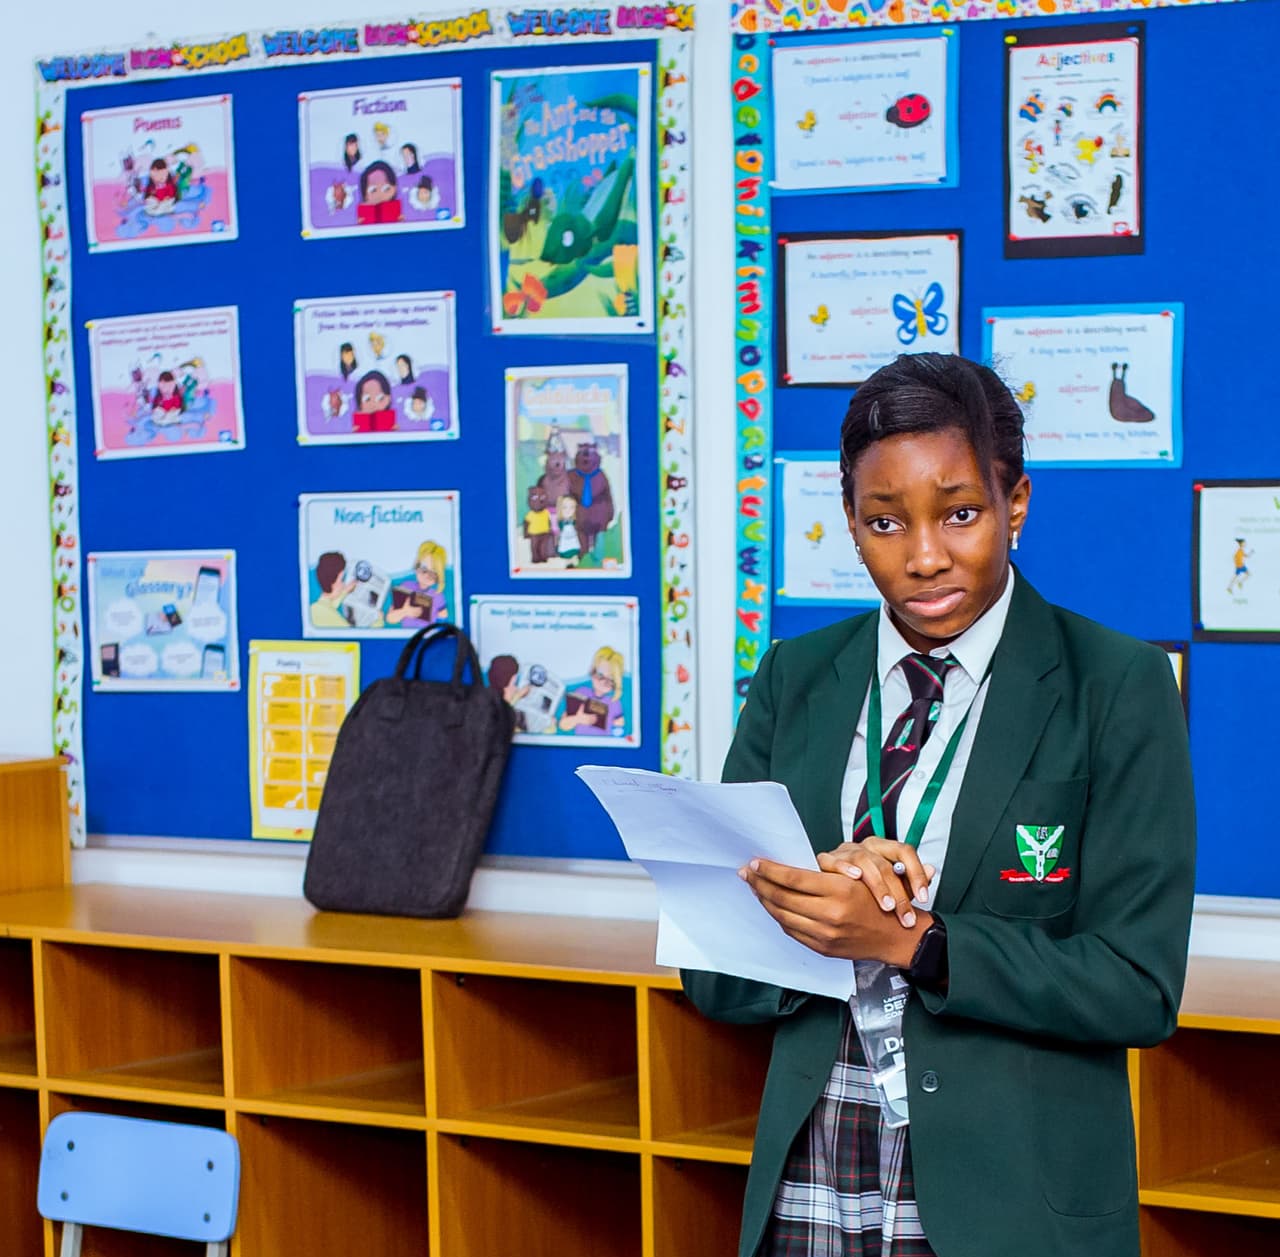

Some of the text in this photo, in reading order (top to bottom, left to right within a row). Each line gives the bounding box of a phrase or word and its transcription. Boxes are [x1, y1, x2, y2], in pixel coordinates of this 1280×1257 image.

[262, 27, 360, 57] WELCOME
[416, 9, 493, 47] SCHOOL
[508, 9, 612, 37] WELCOME
[37, 53, 127, 82] WELCOME
[180, 33, 251, 70] SCHOOL
[1037, 51, 1116, 72] Adjectives
[352, 97, 408, 115] Fiction
[540, 95, 578, 138] Ant
[133, 116, 182, 133] Poems
[509, 122, 630, 189] Grasshopper
[334, 504, 424, 528] Non-fiction
